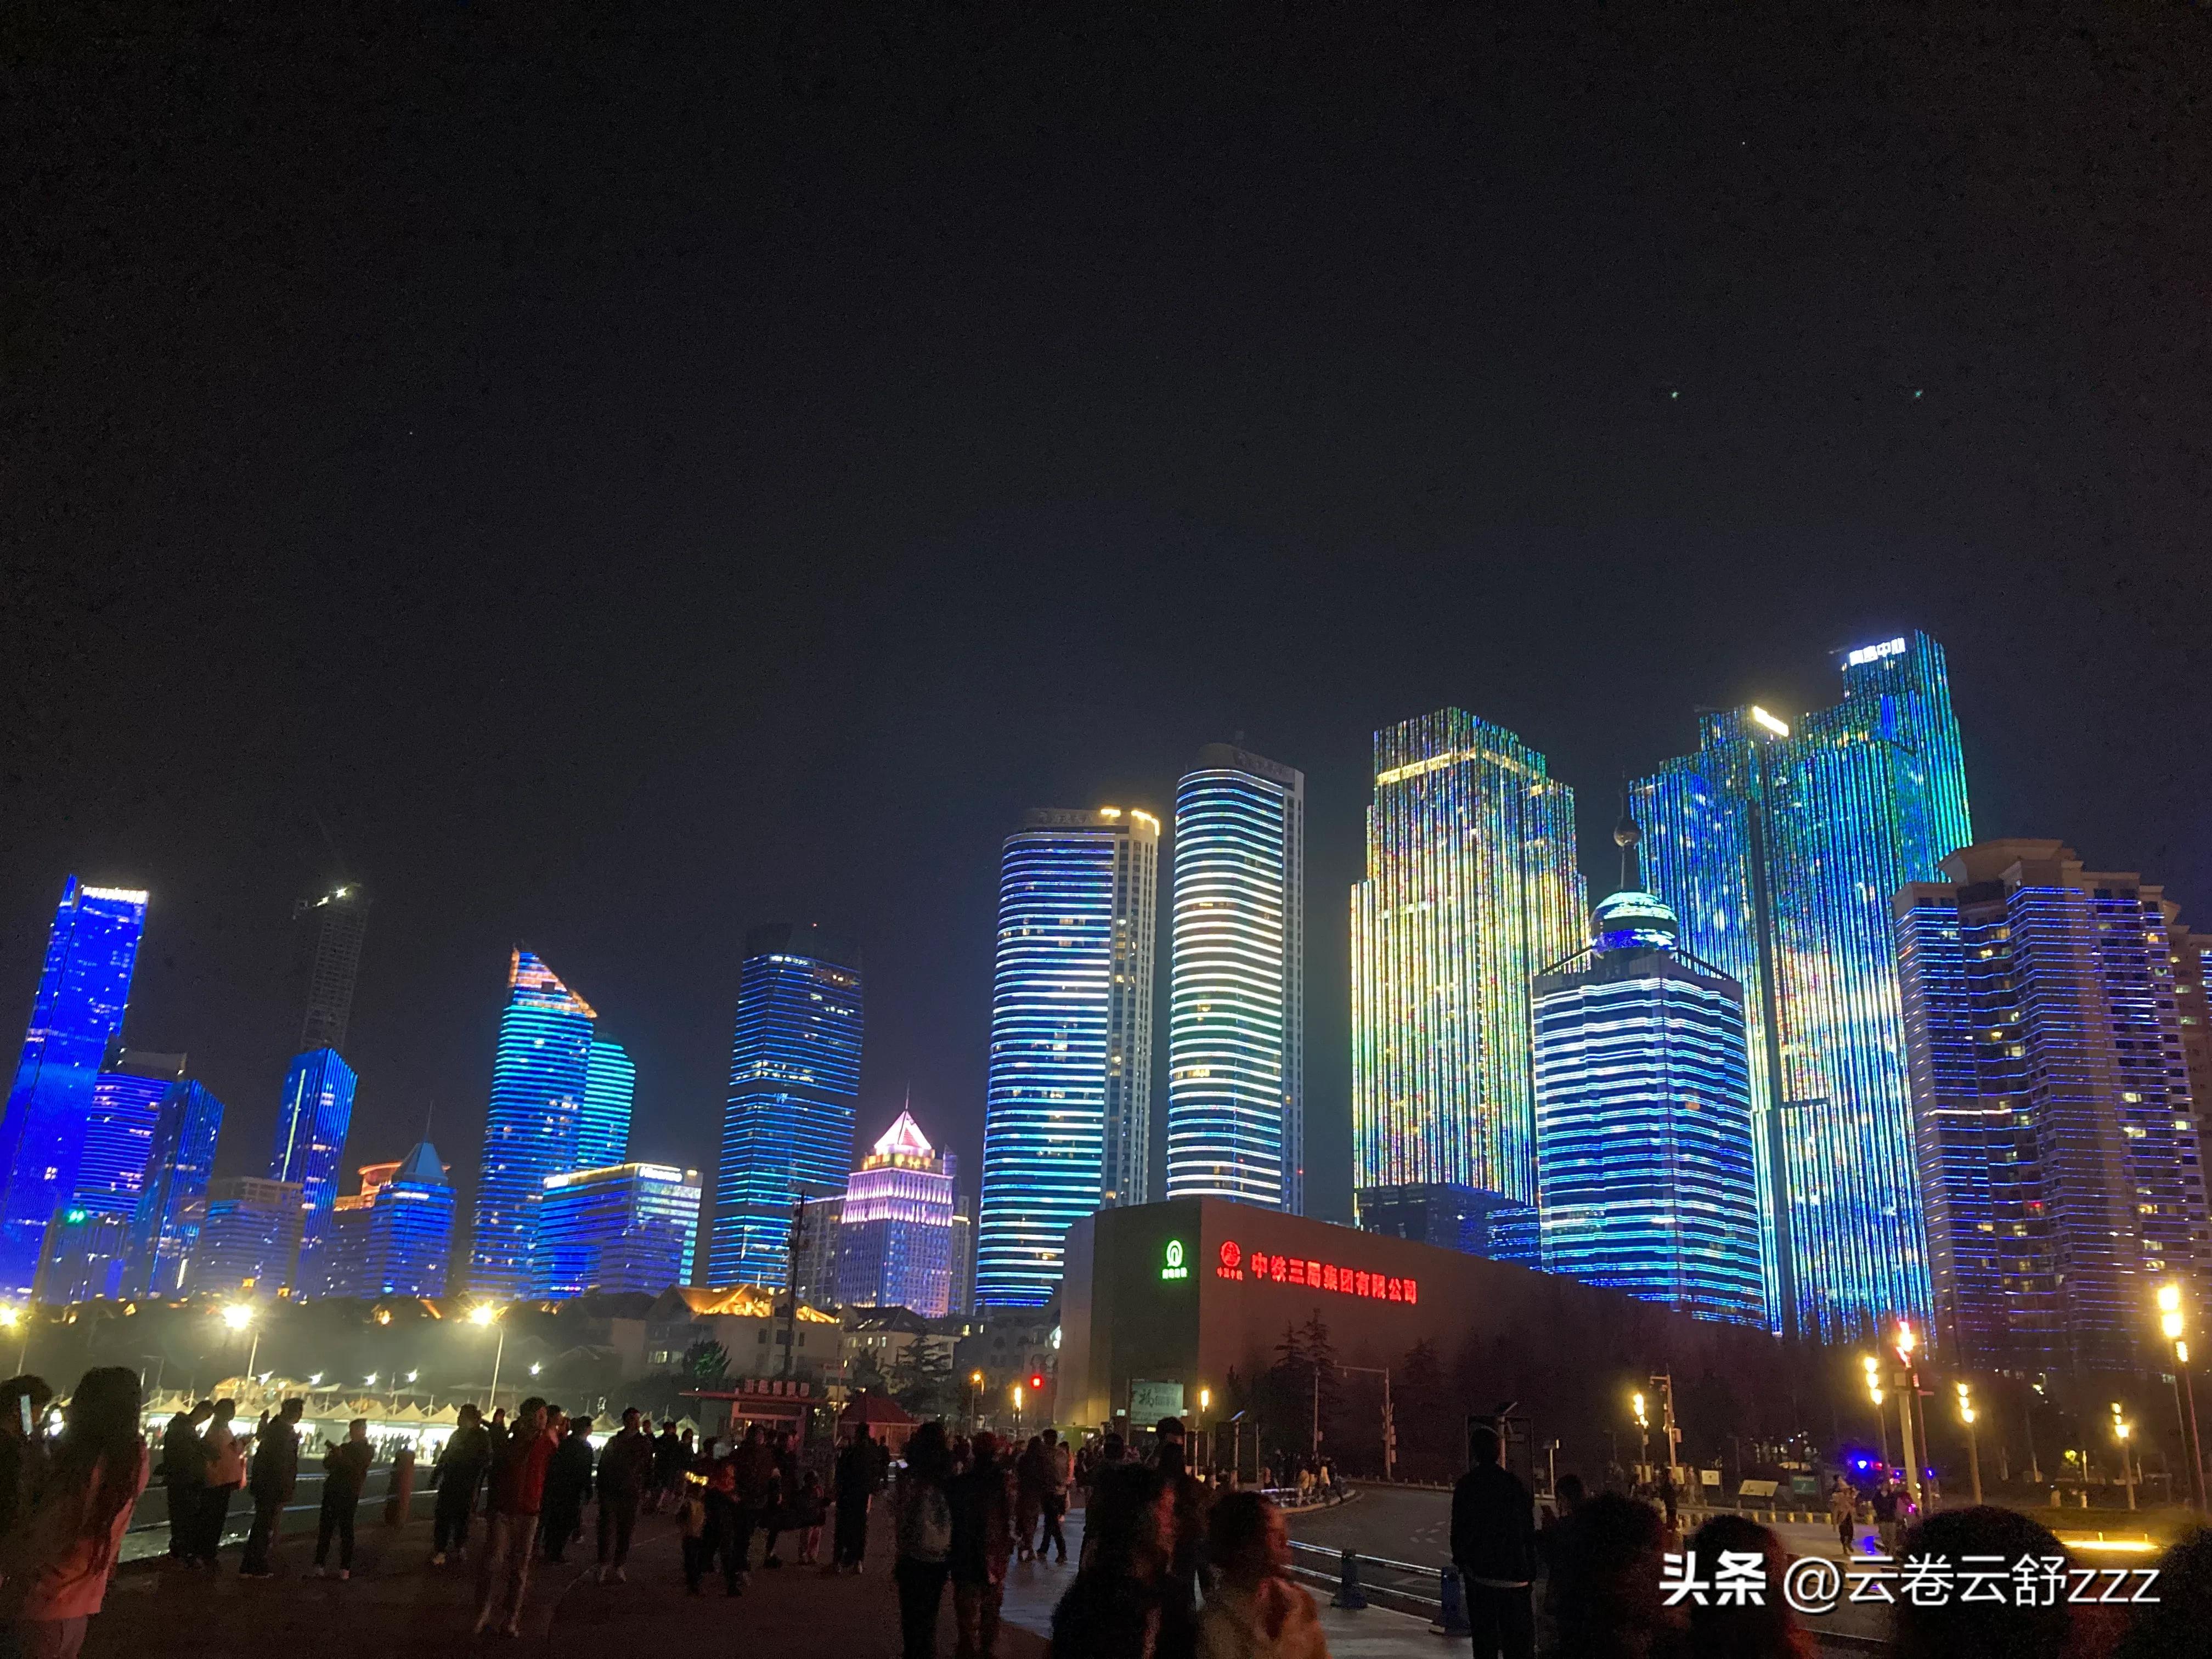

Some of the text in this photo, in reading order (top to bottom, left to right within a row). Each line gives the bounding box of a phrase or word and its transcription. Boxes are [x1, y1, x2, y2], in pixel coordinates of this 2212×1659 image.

[1251, 1252, 1417, 1304] 中铁三局集团有限公司
